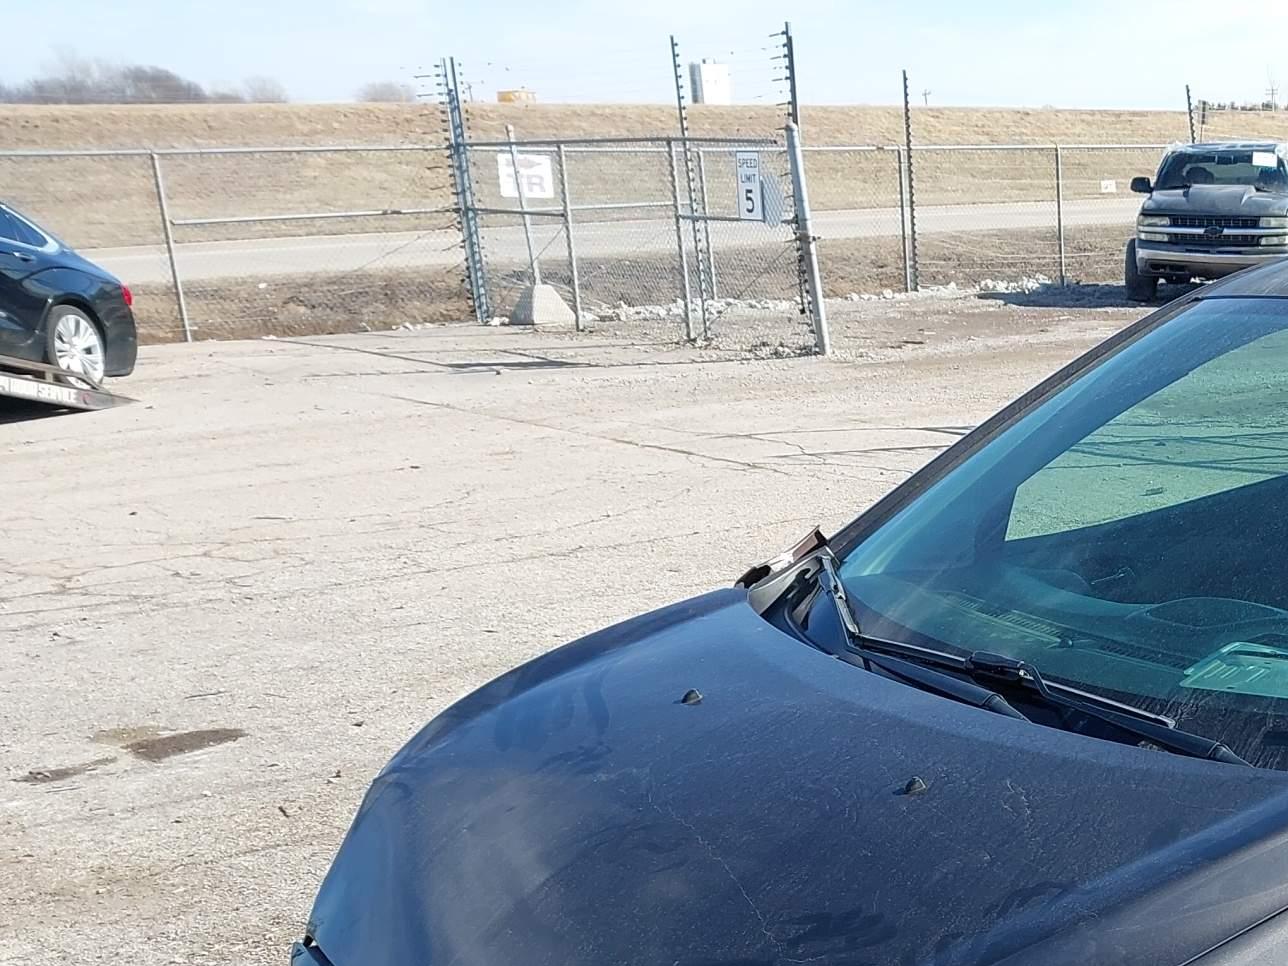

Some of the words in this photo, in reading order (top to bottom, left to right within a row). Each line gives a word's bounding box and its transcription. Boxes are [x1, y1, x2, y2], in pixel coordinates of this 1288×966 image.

[738, 158, 758, 169] SPEED
[740, 173, 756, 184] LIMIT
[745, 188, 755, 214] 5
